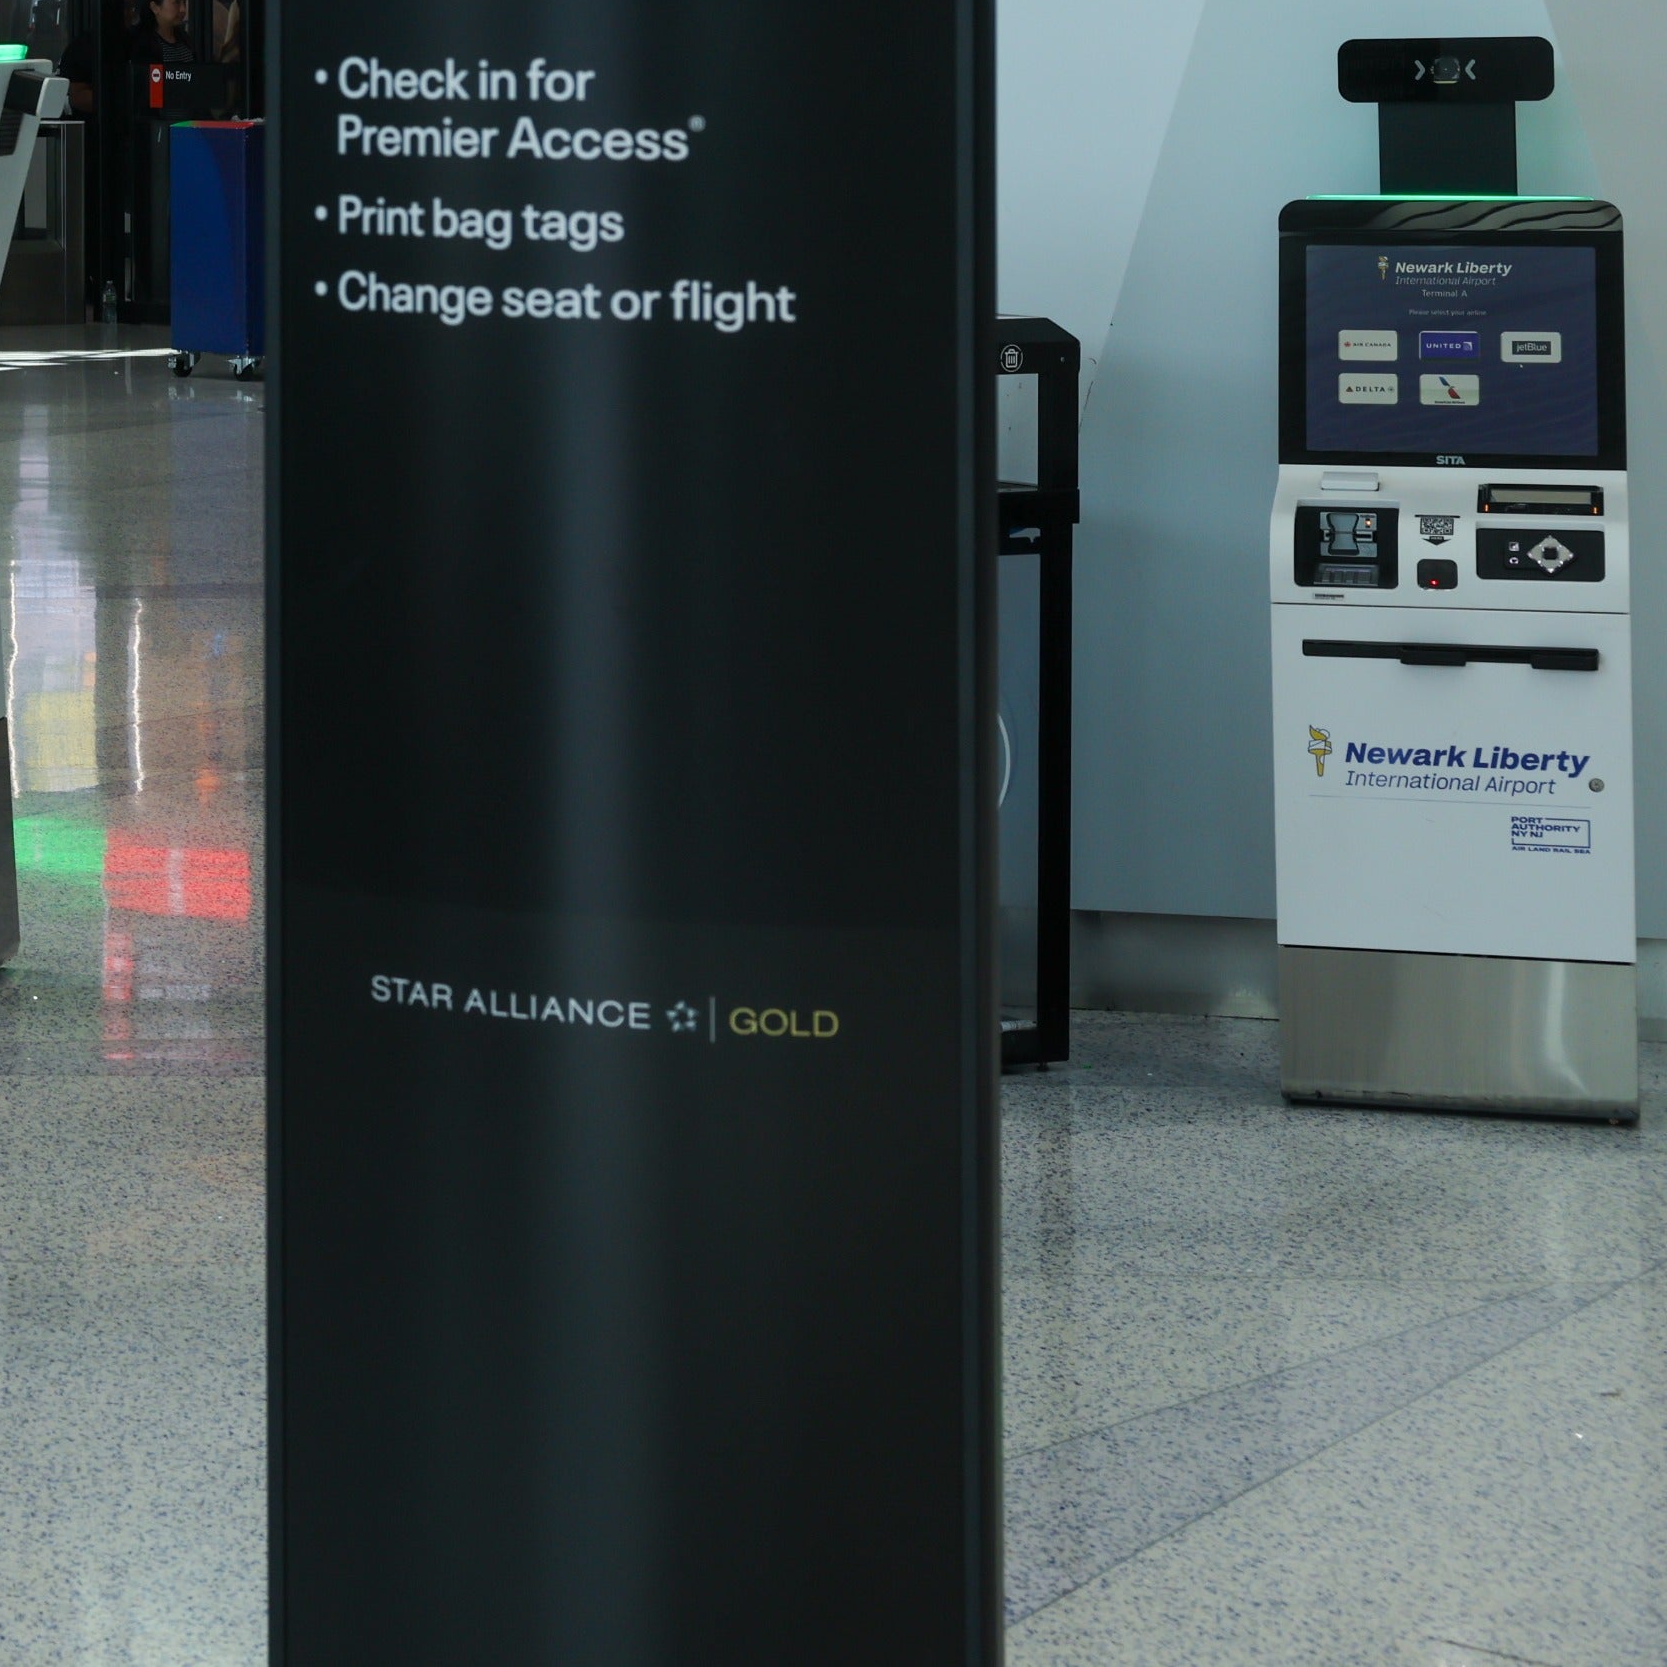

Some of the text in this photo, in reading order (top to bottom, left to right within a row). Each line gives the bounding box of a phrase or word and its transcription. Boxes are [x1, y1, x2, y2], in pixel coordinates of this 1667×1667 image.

[165, 71, 191, 81] No Entry
[338, 56, 595, 101] Check in for
[338, 114, 499, 158] Premier
[338, 195, 625, 250] Print bag tags
[1396, 262, 1512, 276] Newark Liberty
[1396, 276, 1496, 287] International Airport
[338, 270, 796, 332] Change seat or flight
[1516, 343, 1547, 352] jetBlue
[1436, 455, 1465, 466] SITA
[1345, 742, 1590, 778] Newark Liberty
[1345, 770, 1556, 796] International Airport
[1511, 823, 1580, 832] AUTHORITY
[371, 975, 839, 1037] STAR ALLIANCE GOLD
